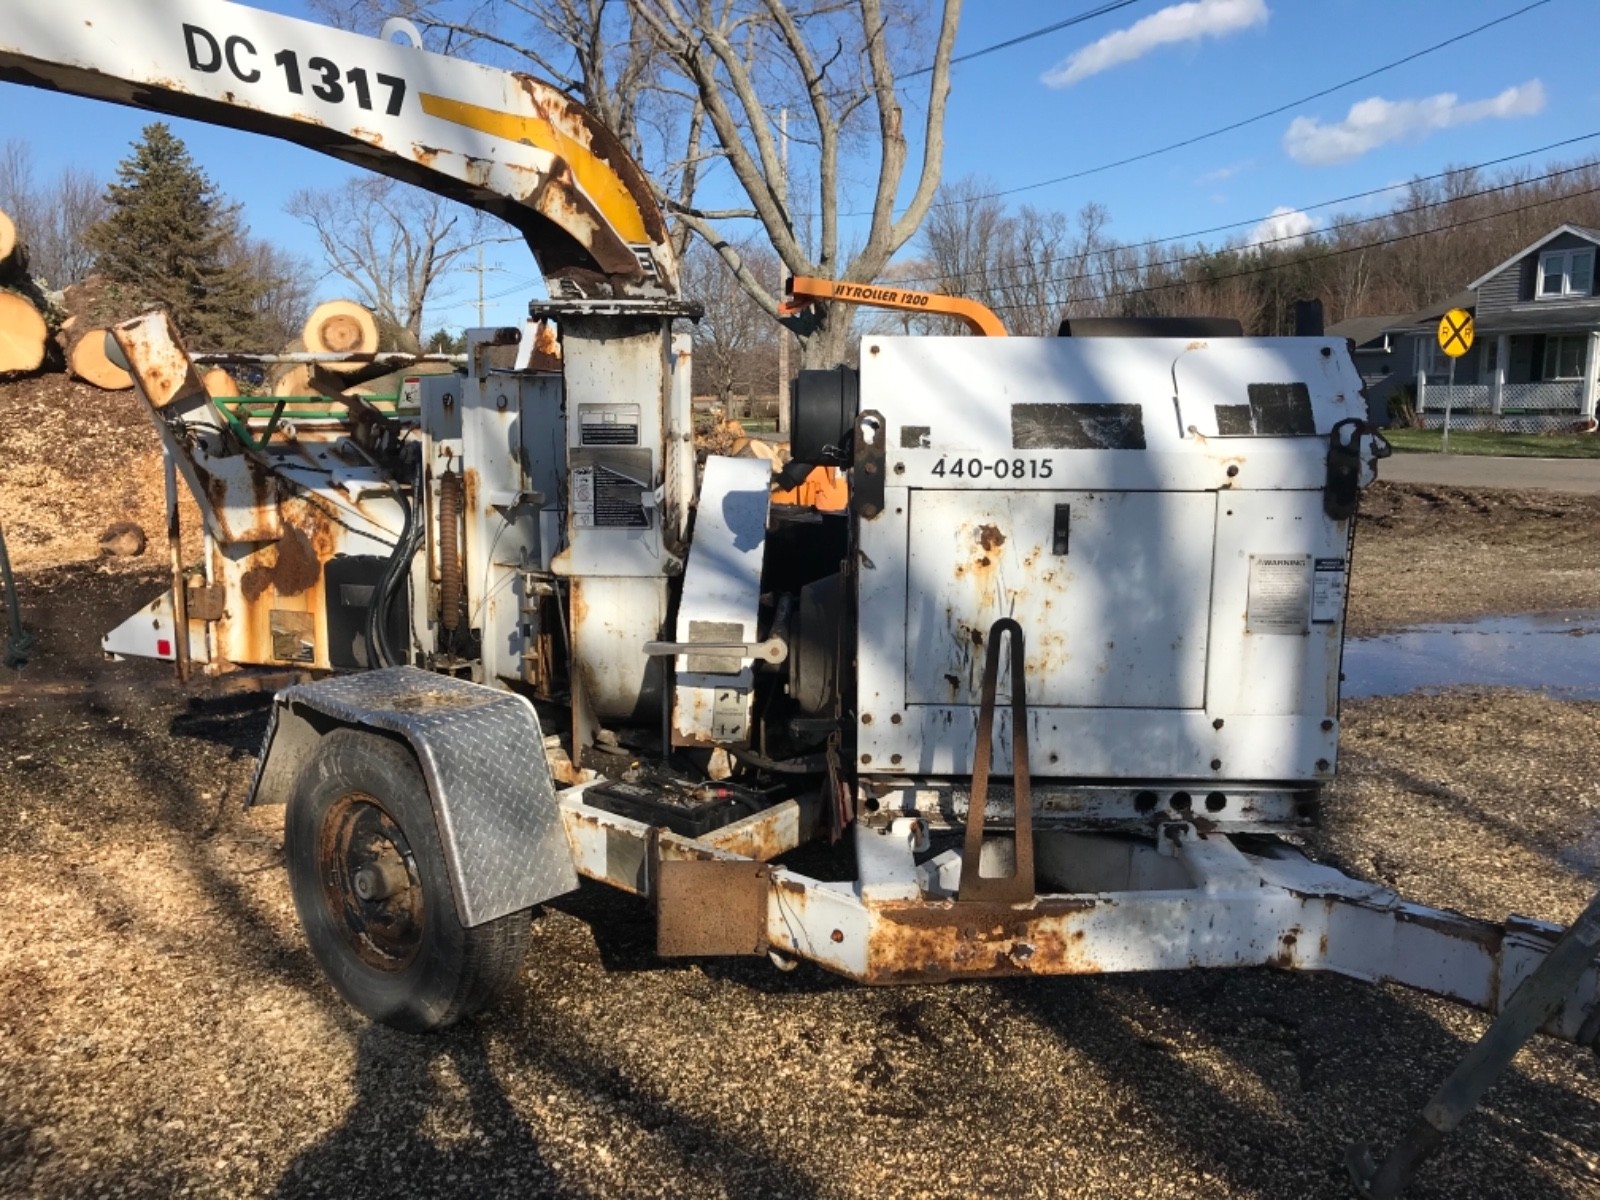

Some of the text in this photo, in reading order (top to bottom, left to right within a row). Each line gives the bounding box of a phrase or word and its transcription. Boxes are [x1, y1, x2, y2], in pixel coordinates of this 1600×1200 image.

[182, 23, 407, 117] DC 1317
[835, 284, 929, 306] HYROLLER 1200
[931, 458, 1054, 479] 440-0815
